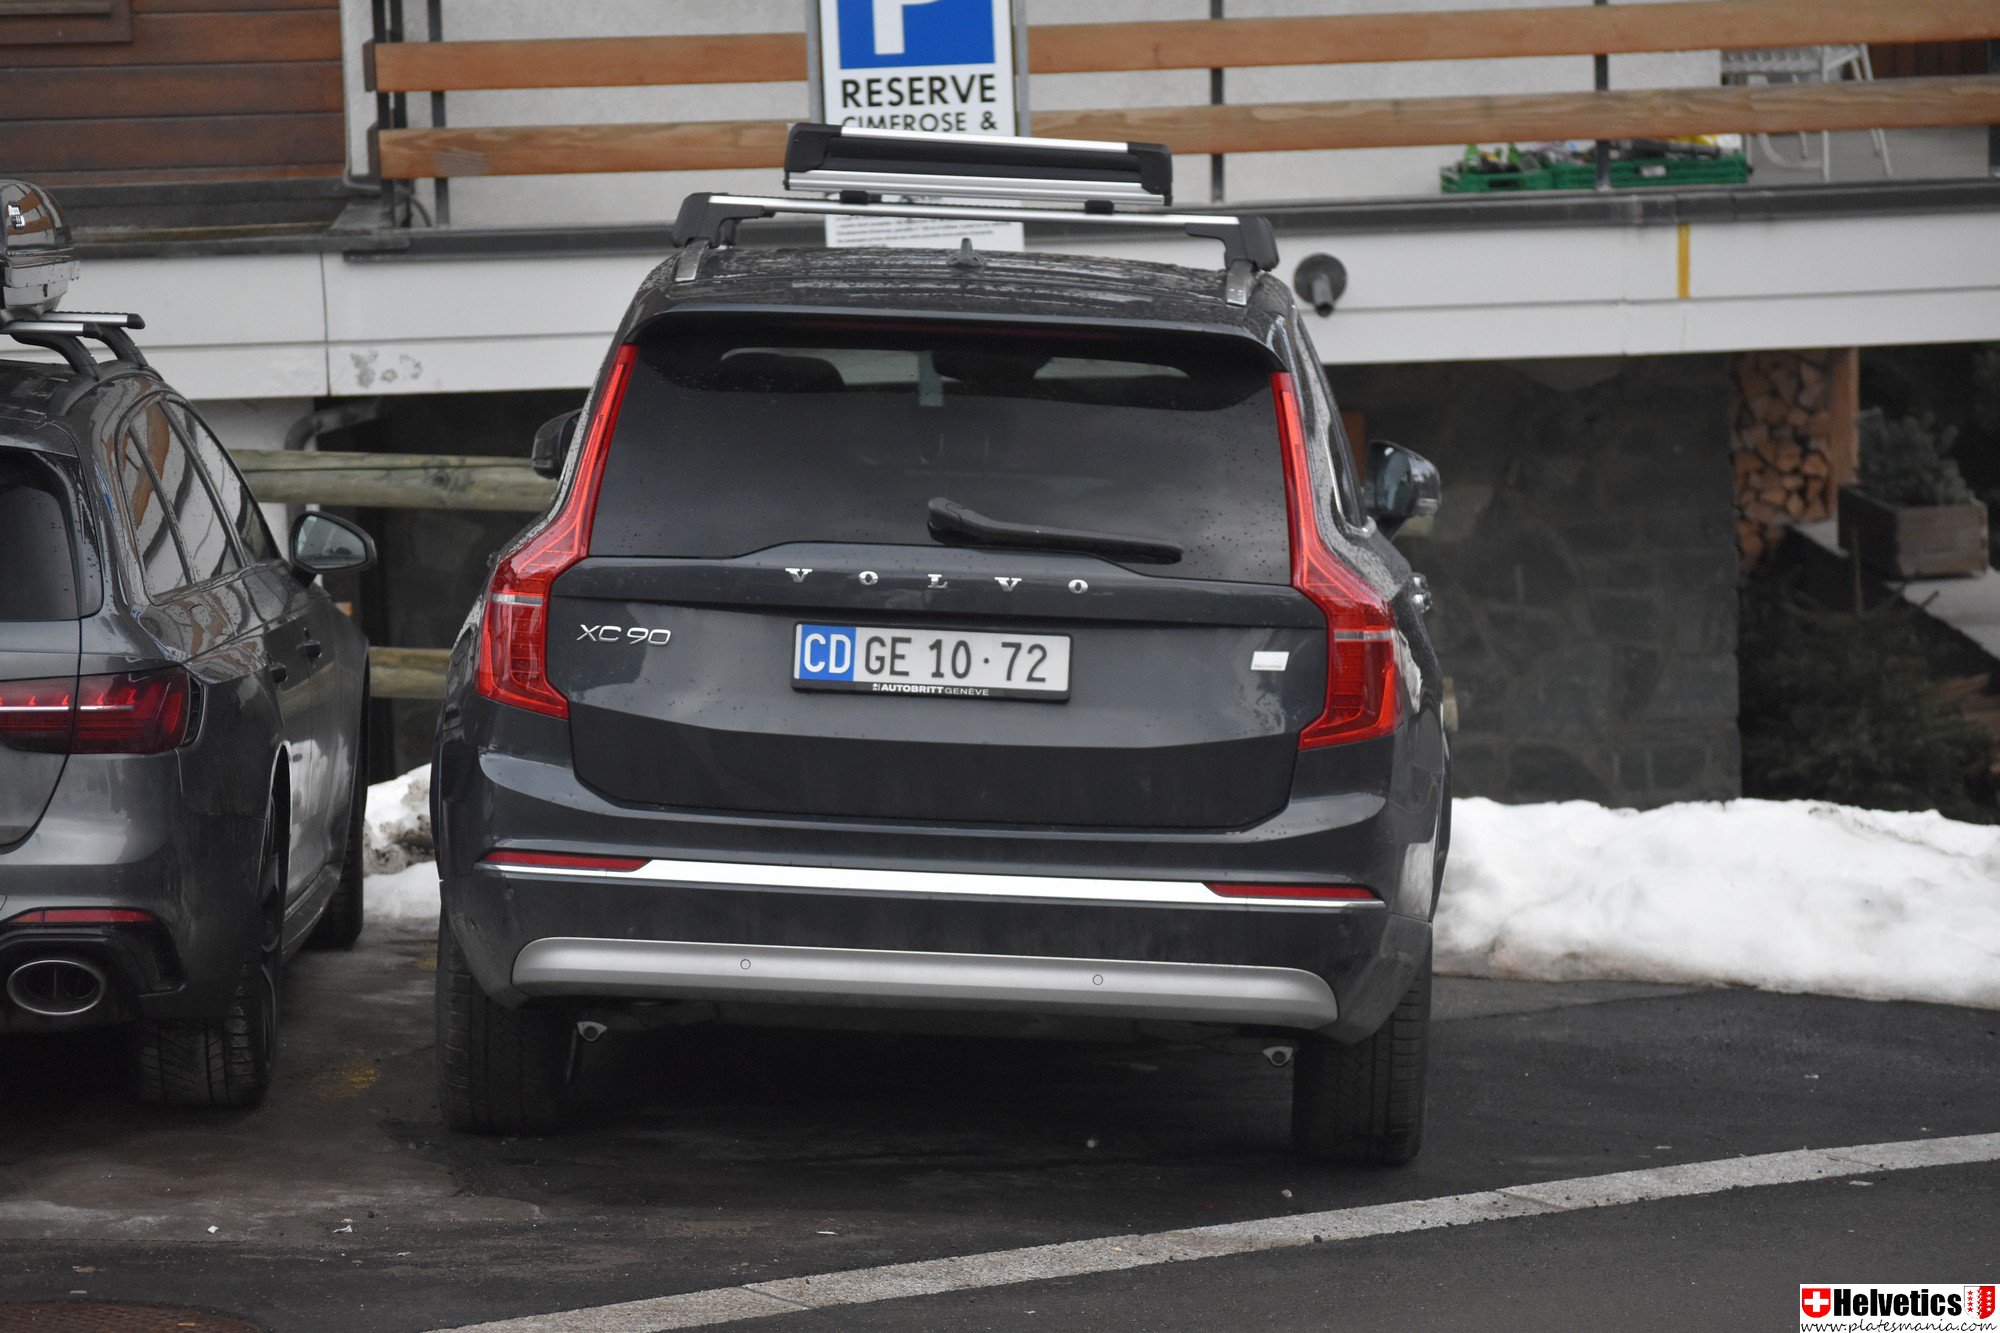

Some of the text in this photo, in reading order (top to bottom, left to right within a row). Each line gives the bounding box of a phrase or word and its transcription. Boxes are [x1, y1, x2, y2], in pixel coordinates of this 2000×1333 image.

[841, 74, 996, 108] RESERVE
[981, 111, 998, 130] &
[785, 568, 1089, 594] VOLVO
[804, 633, 852, 674] CD
[865, 636, 912, 676] GE
[881, 683, 944, 694] AUTOBRITT
